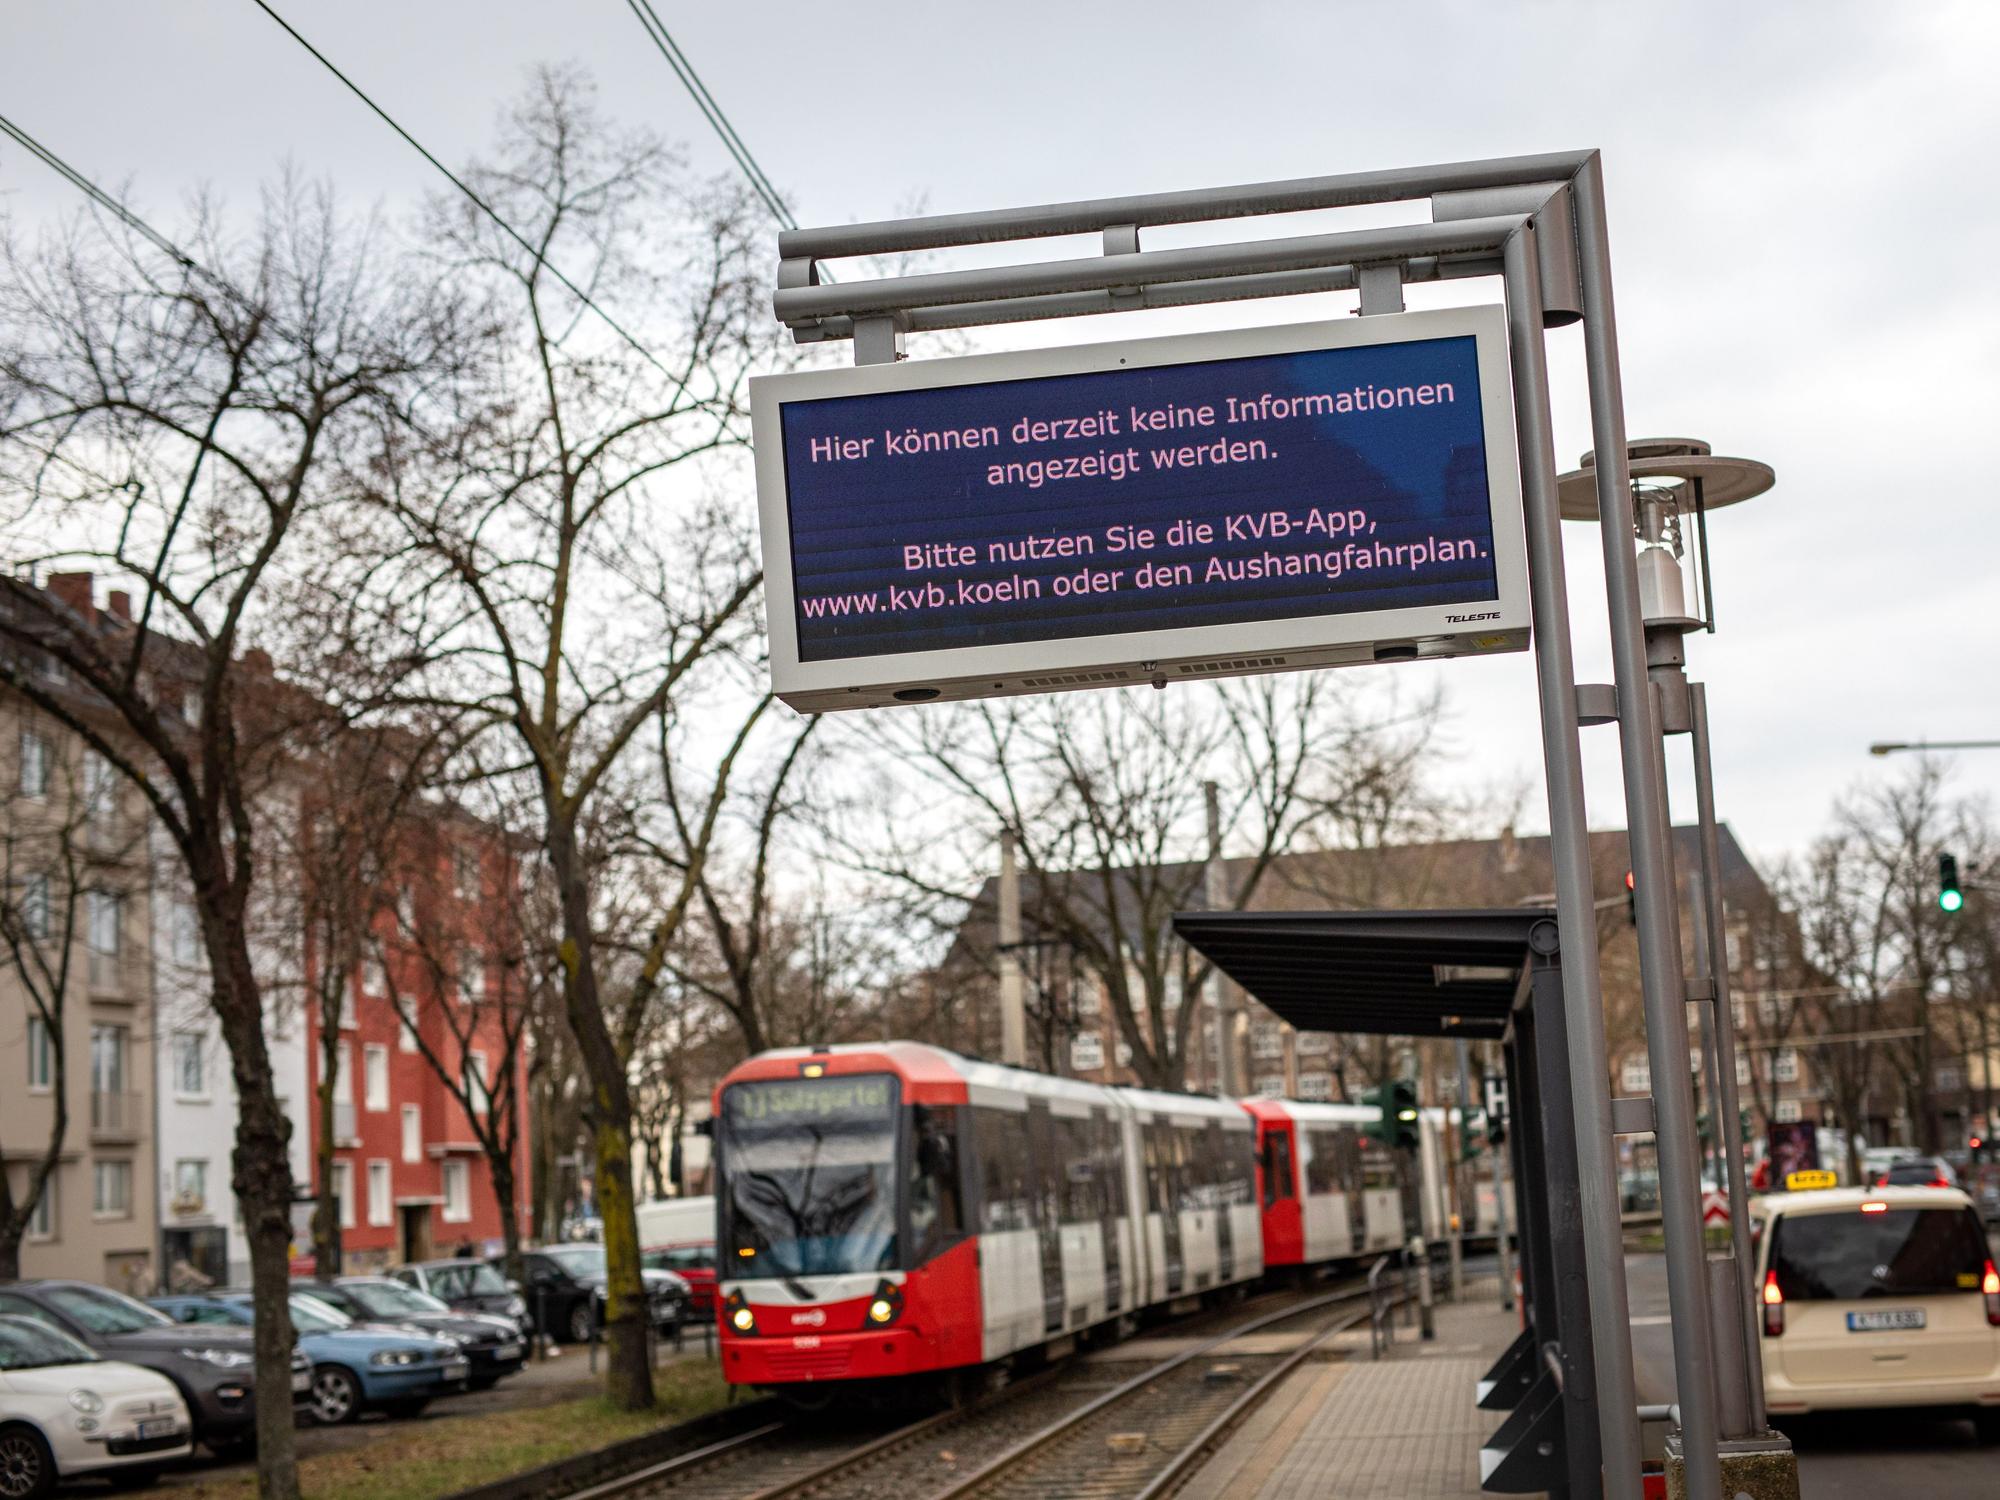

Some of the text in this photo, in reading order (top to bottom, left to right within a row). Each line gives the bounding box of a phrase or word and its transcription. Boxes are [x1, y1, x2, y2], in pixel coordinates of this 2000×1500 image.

[810, 383, 1455, 463] Hier können derzeit keine Informationen
[987, 436, 1278, 488] angezeigt werden.
[903, 508, 1377, 571] Bitte nutzen Sie die KVB-App,
[802, 536, 1487, 619] www.kvb.koeln oder den Aushangfahrplan.
[1444, 611, 1501, 623] TELESTE
